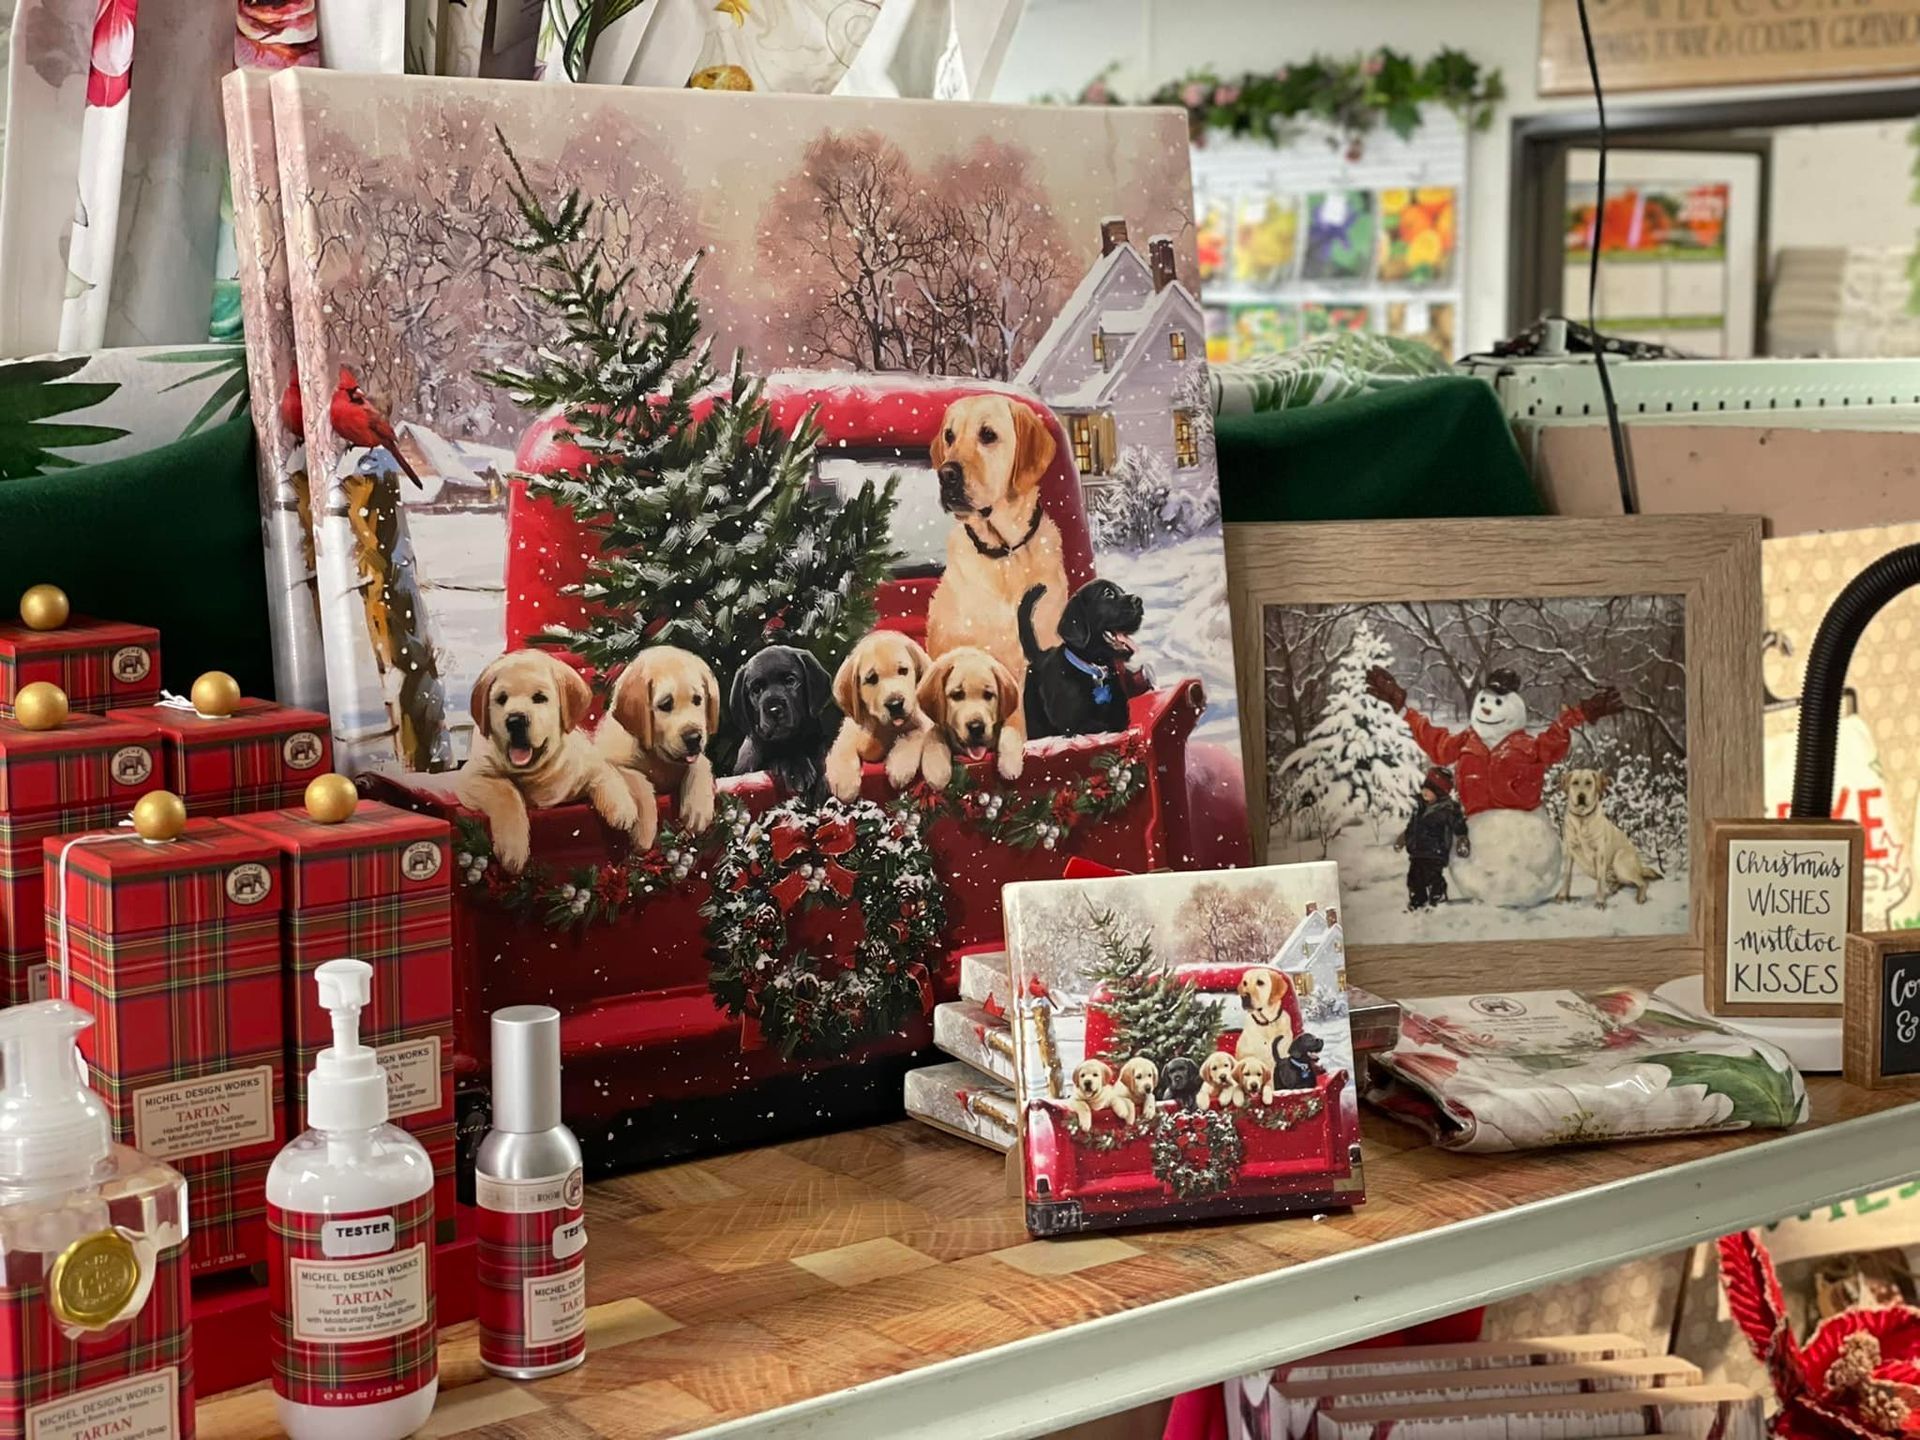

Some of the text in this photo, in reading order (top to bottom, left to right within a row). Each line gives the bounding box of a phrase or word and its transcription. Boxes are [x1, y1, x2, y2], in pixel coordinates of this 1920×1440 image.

[1736, 850, 1844, 878] Christmas
[1747, 883, 1831, 916] WISHES
[1735, 963, 1838, 994] KISSES
[1890, 968, 1920, 1007] Co
[398, 1048, 430, 1060] WORKS
[145, 1078, 260, 1107] MICHEL DESIGN WORKS
[176, 1102, 231, 1122] TARTAN
[336, 1222, 391, 1238] TESTER
[302, 1258, 418, 1281] MICHEL DESIGN WORKS
[333, 1287, 394, 1306] TARTAN
[535, 1283, 566, 1296] MICHEL
[318, 1307, 341, 1315] Hand
[342, 1306, 358, 1314] and
[39, 1383, 165, 1427] MICHEL DESIGN WORKS
[72, 1415, 133, 1440] TARTAN
